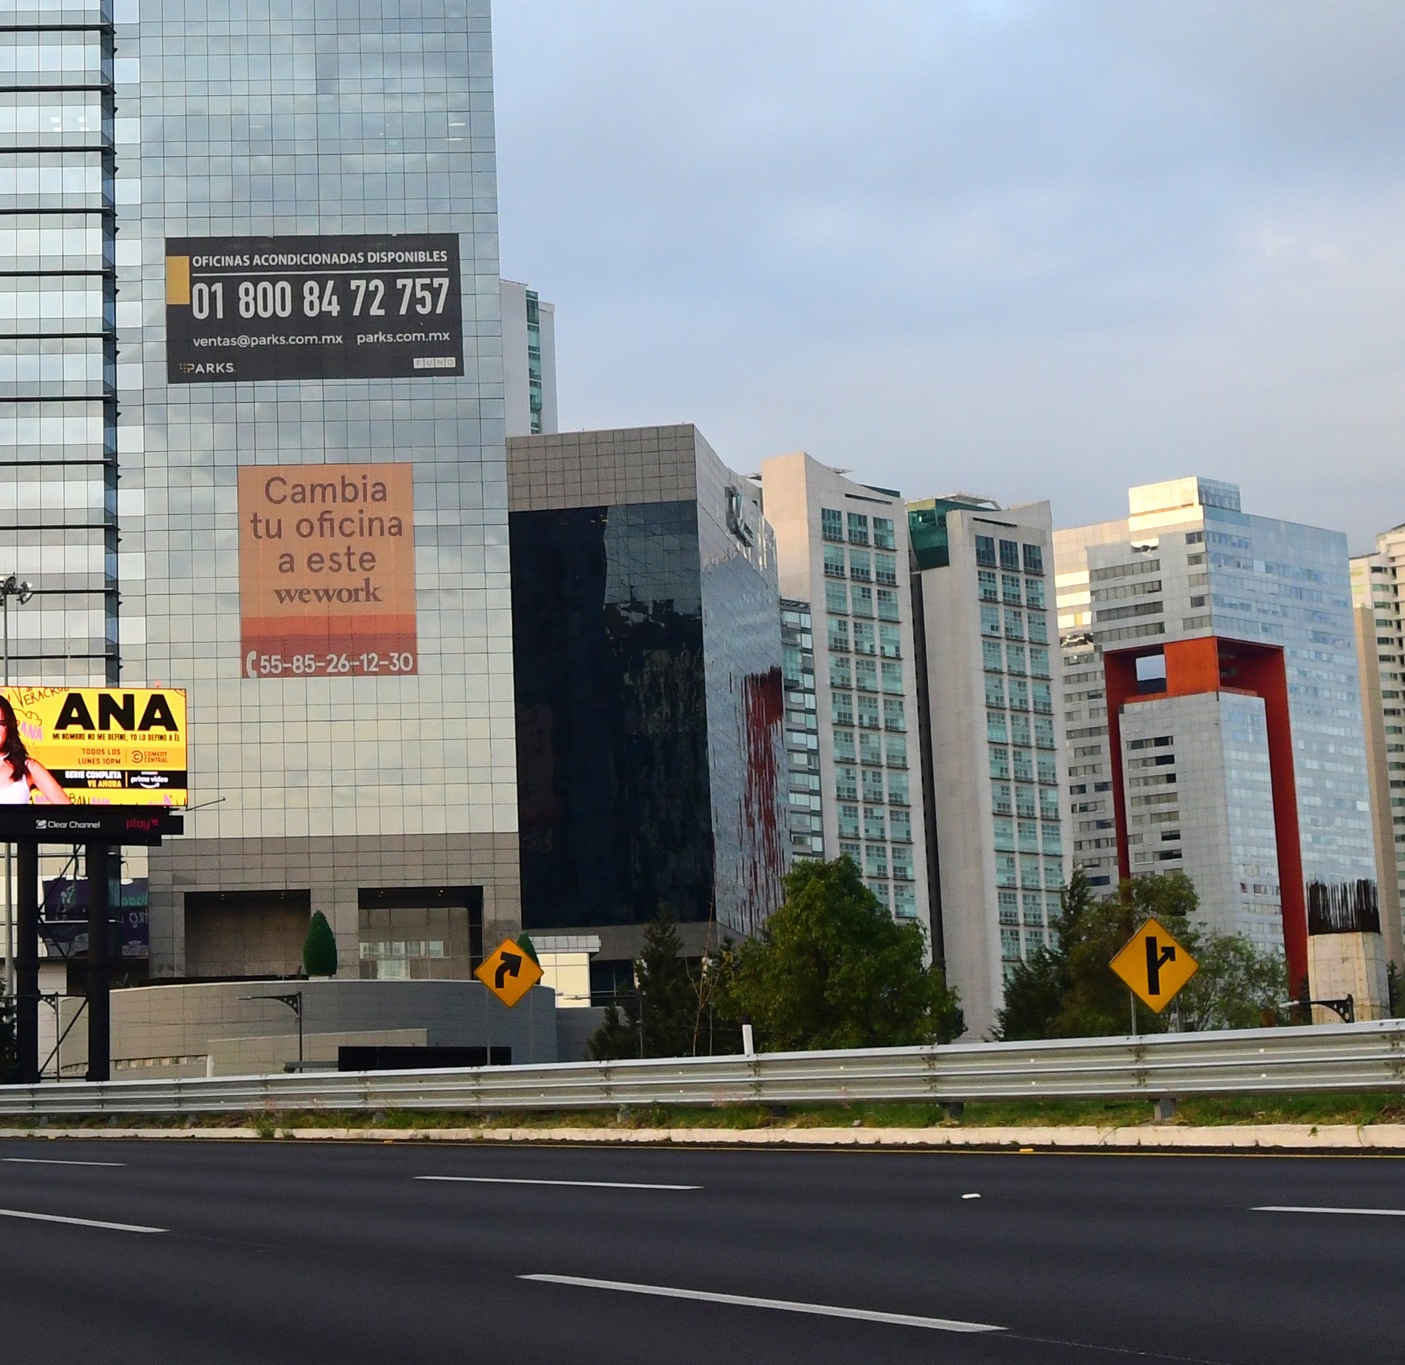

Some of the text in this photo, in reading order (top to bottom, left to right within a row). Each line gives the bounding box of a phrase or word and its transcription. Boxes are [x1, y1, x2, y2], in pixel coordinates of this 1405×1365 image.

[192, 250, 448, 268] OFICINAS ACONDICIONADAS DISPONIBLES
[192, 277, 450, 320] 01 800 84 72 757
[192, 330, 450, 348] ventas@parks.com.mx parks.com.mx
[264, 474, 388, 505] Cambia
[249, 509, 403, 540] tu oficina
[278, 545, 377, 574] a este
[273, 577, 384, 605] wework
[259, 652, 414, 674] 55-85-26-12-30
[53, 692, 179, 732] ANA
[130, 733, 138, 741] YO
[78, 757, 101, 765] LUNES
[82, 748, 121, 756] TODOS LOS
[97, 780, 122, 788] AHORA
[47, 820, 101, 829] Clear Channel
